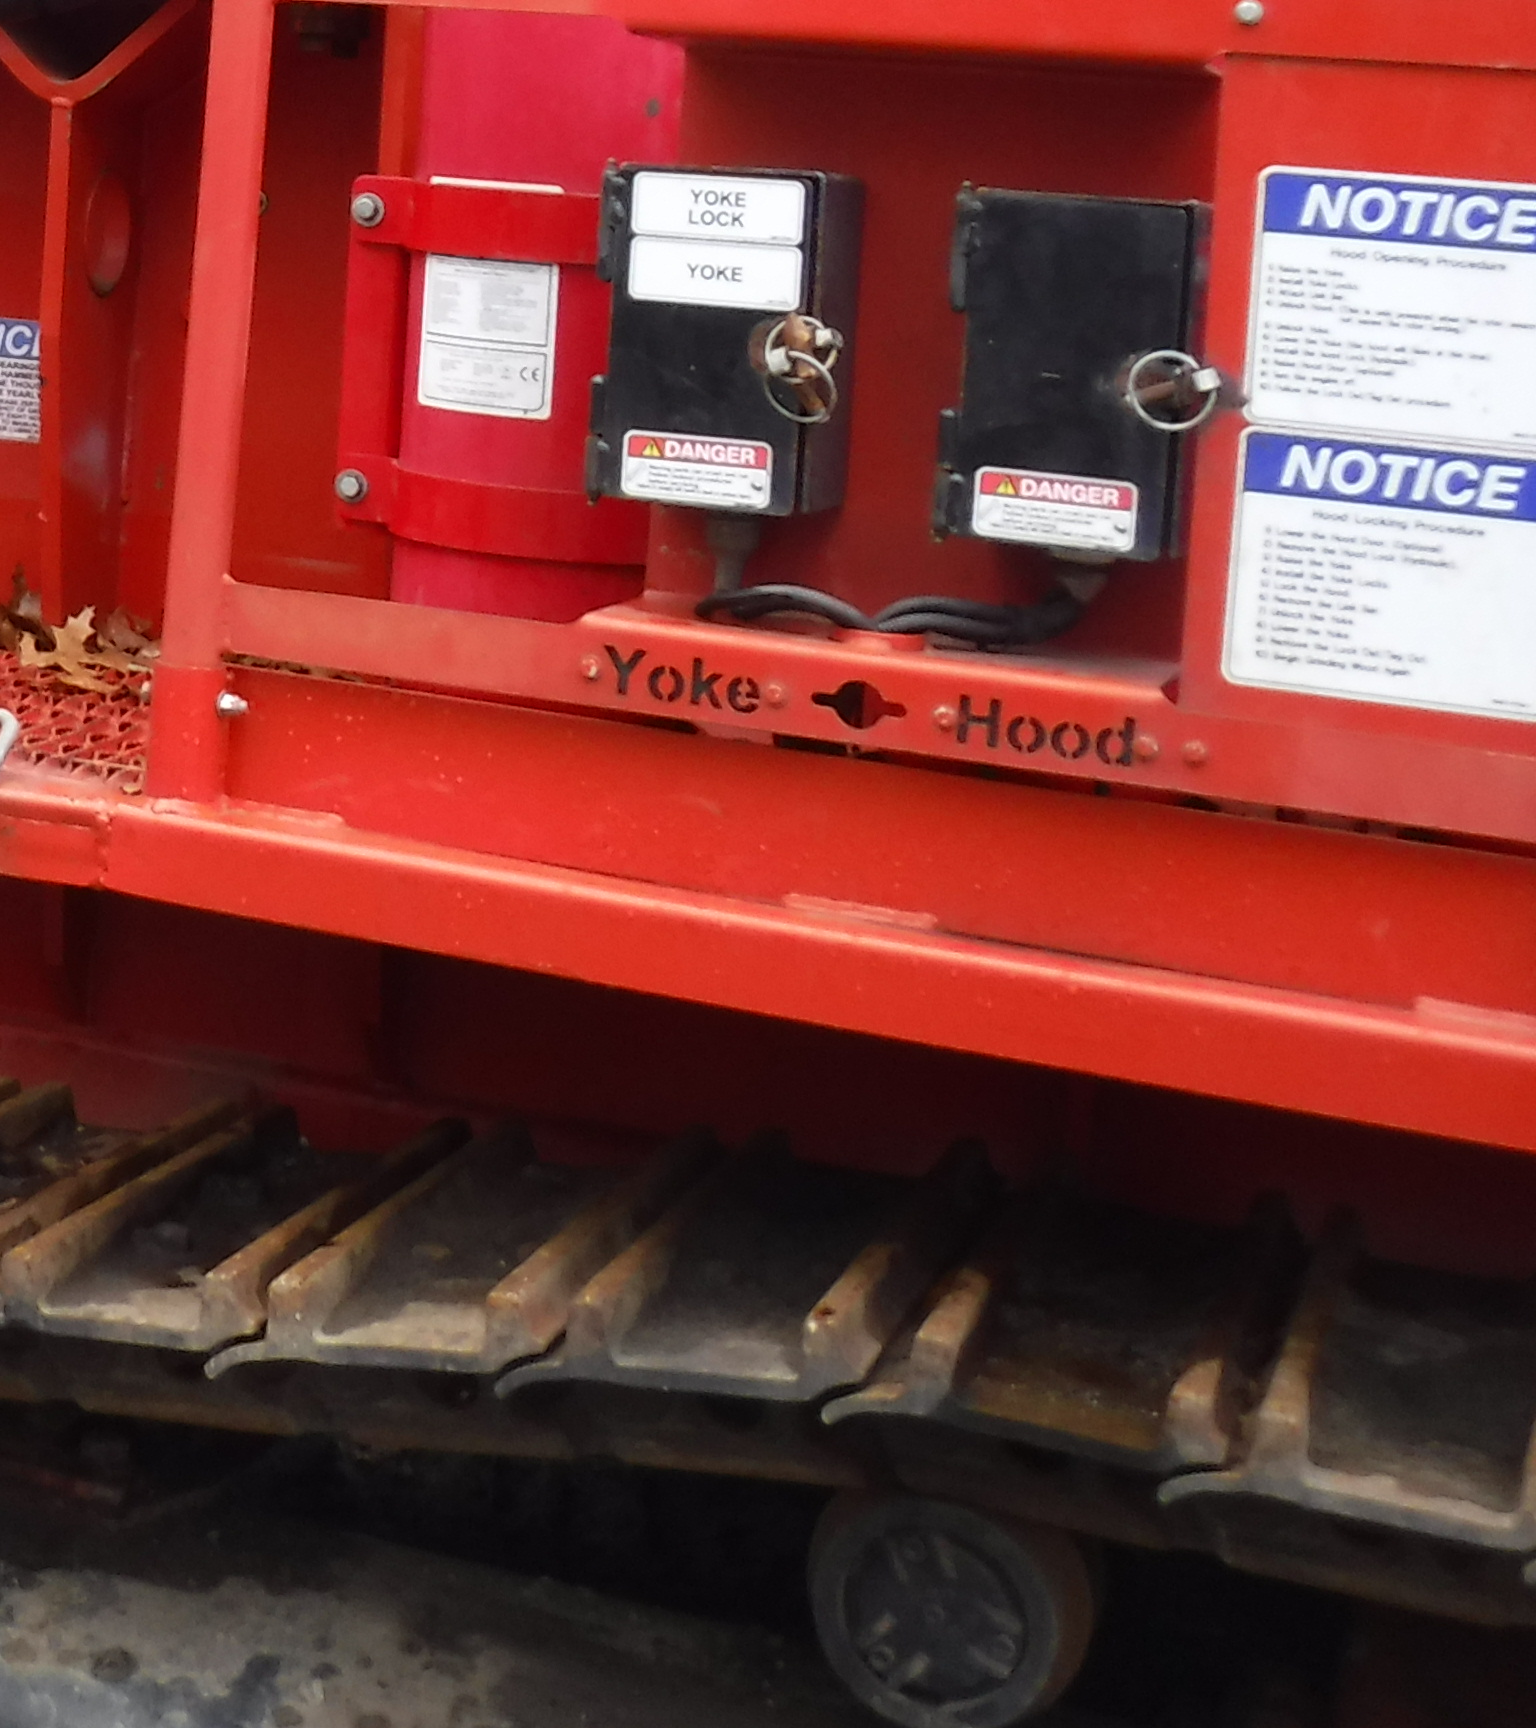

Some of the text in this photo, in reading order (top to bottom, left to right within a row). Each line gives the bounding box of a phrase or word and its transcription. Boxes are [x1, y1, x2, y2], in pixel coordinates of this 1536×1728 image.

[691, 189, 747, 208] YOKE
[688, 209, 744, 228] LOCK
[1300, 183, 1536, 245] NOTICE
[687, 263, 743, 283] YOKE
[664, 440, 756, 466] DANGER
[1280, 444, 1528, 511] NOTICE
[1019, 478, 1120, 507] DANGER
[604, 644, 761, 714] Yoke
[955, 693, 1138, 766] Hood
